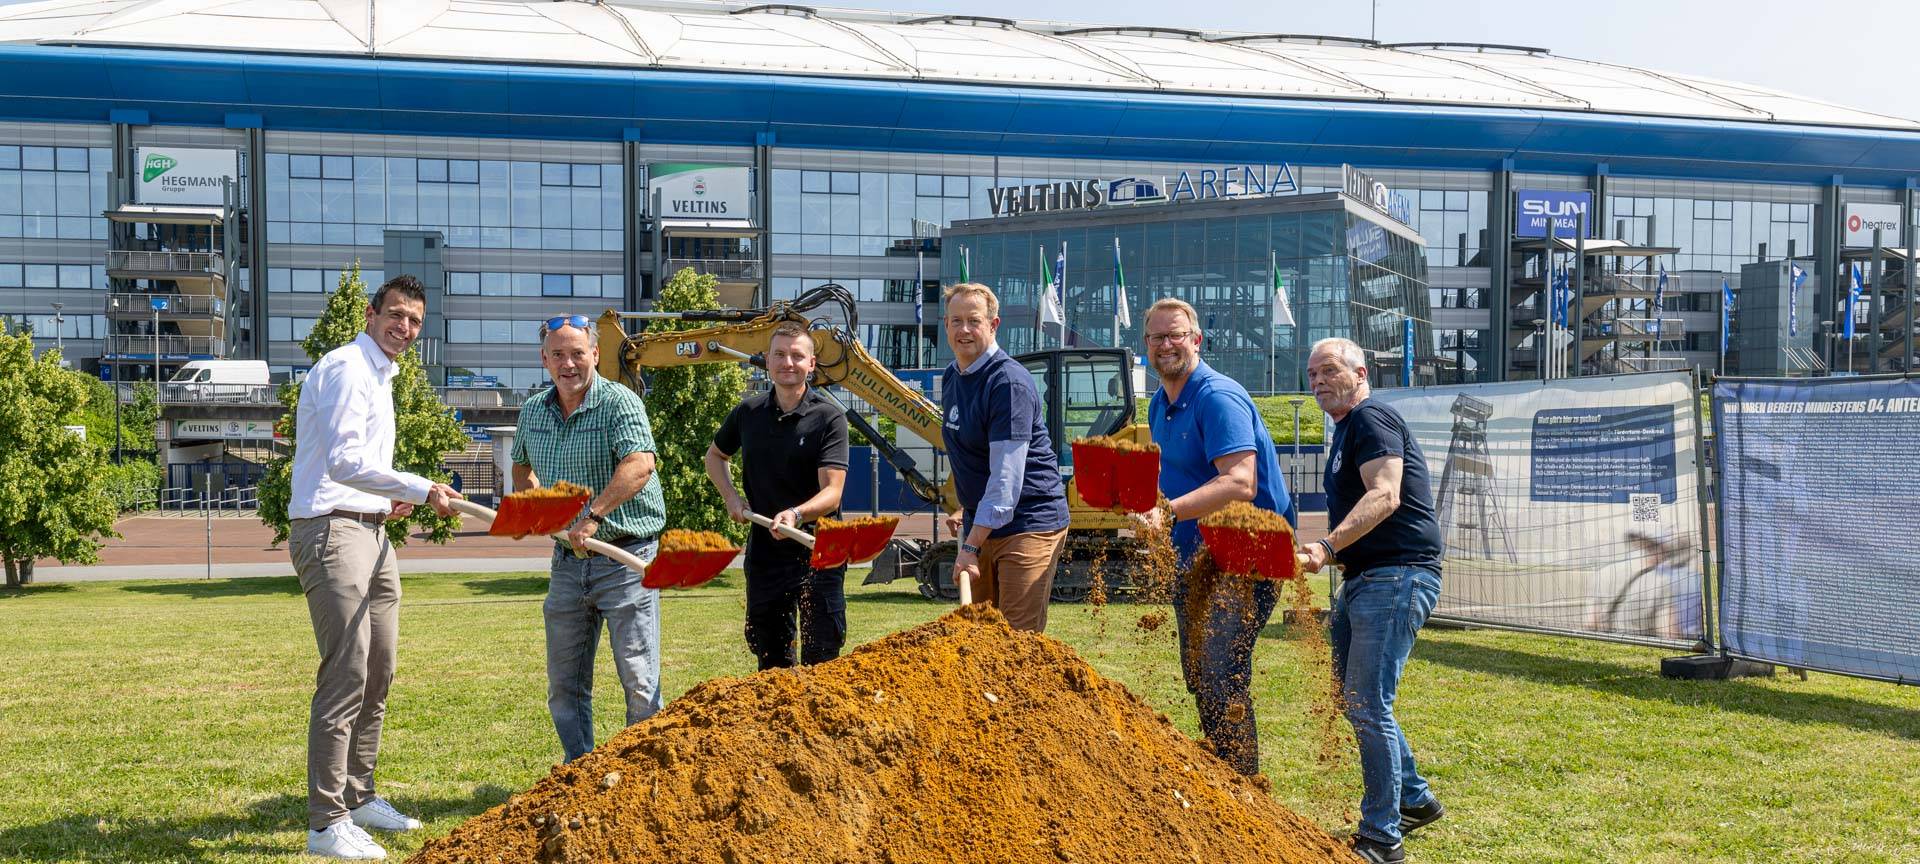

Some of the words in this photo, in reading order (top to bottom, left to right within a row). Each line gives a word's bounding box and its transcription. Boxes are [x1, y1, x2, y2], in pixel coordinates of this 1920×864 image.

[146, 160, 171, 169] HGH
[987, 178, 1102, 216] VELTINS
[1172, 161, 1299, 202] ARENA
[673, 199, 727, 214] VELTINS
[1523, 199, 1587, 216] SUN
[1862, 218, 1897, 231] heatrex
[161, 302, 168, 310] 2
[676, 341, 697, 356] CAT
[849, 367, 931, 428] HULLMANN
[1767, 402, 1805, 414] BEREITS
[1805, 401, 1867, 414] MINDESTENS
[1867, 398, 1884, 413] 04
[188, 424, 219, 433] VELTINS
